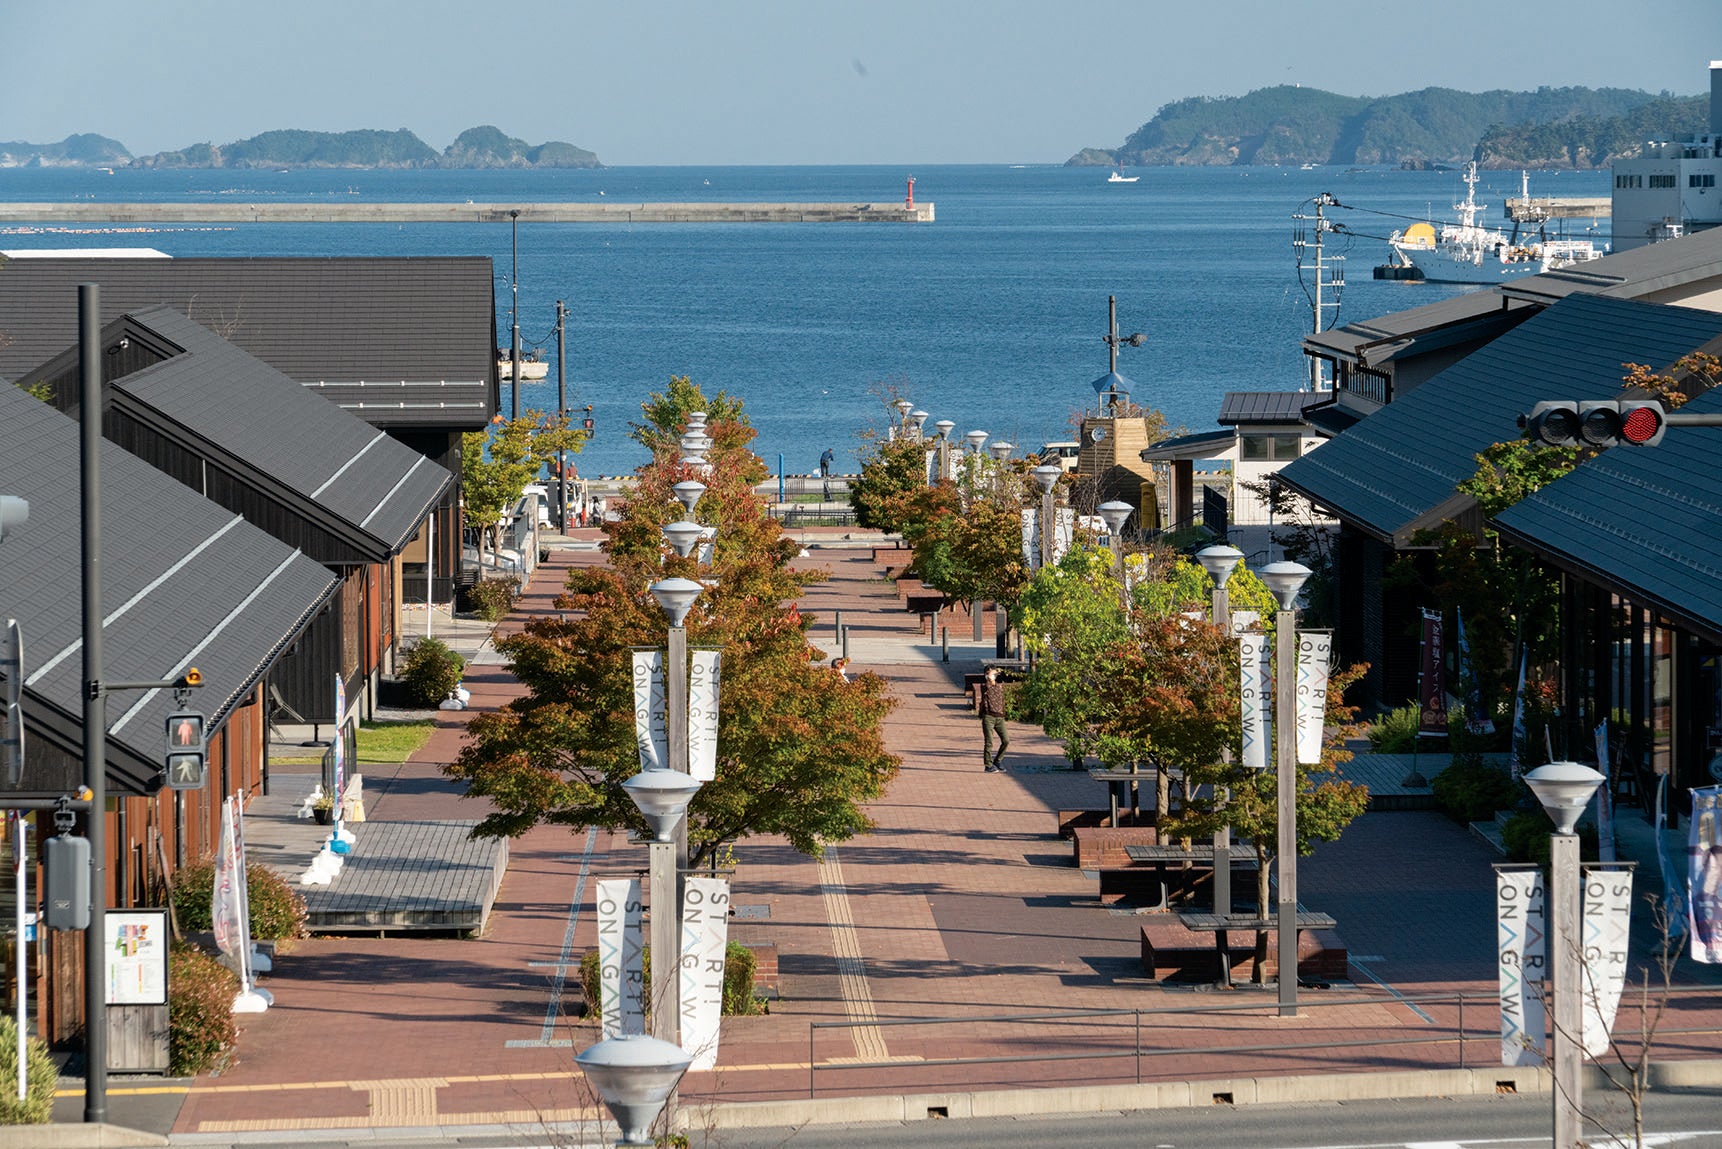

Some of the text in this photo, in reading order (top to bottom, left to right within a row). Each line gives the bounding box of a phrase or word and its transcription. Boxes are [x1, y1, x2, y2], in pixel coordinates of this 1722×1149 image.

[651, 665, 667, 743] START!
[705, 666, 720, 742] START!
[1258, 645, 1271, 723] START!
[1312, 644, 1330, 720] START!
[624, 901, 644, 1016] START!
[705, 892, 729, 1005] START!
[1526, 886, 1544, 1000] START!
